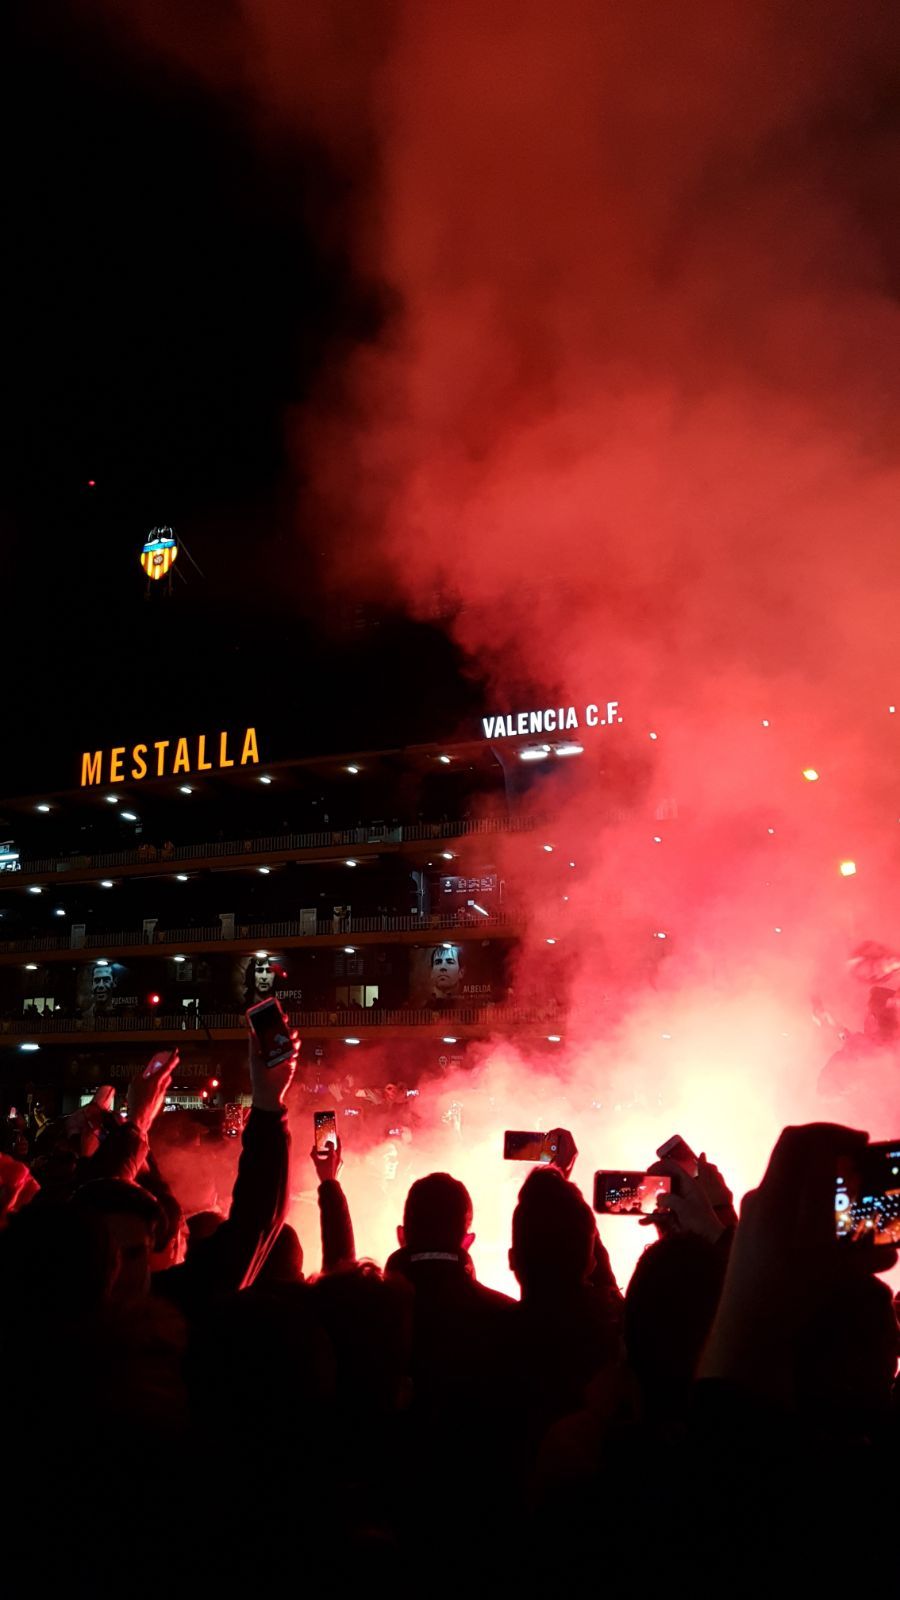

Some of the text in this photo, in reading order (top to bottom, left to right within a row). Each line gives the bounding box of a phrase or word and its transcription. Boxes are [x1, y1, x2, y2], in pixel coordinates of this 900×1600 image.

[482, 701, 624, 739] VALENCIA C.F.
[80, 727, 260, 787] MESTALLA
[275, 989, 303, 1000] KEMPES
[463, 984, 491, 994] ALBELDA
